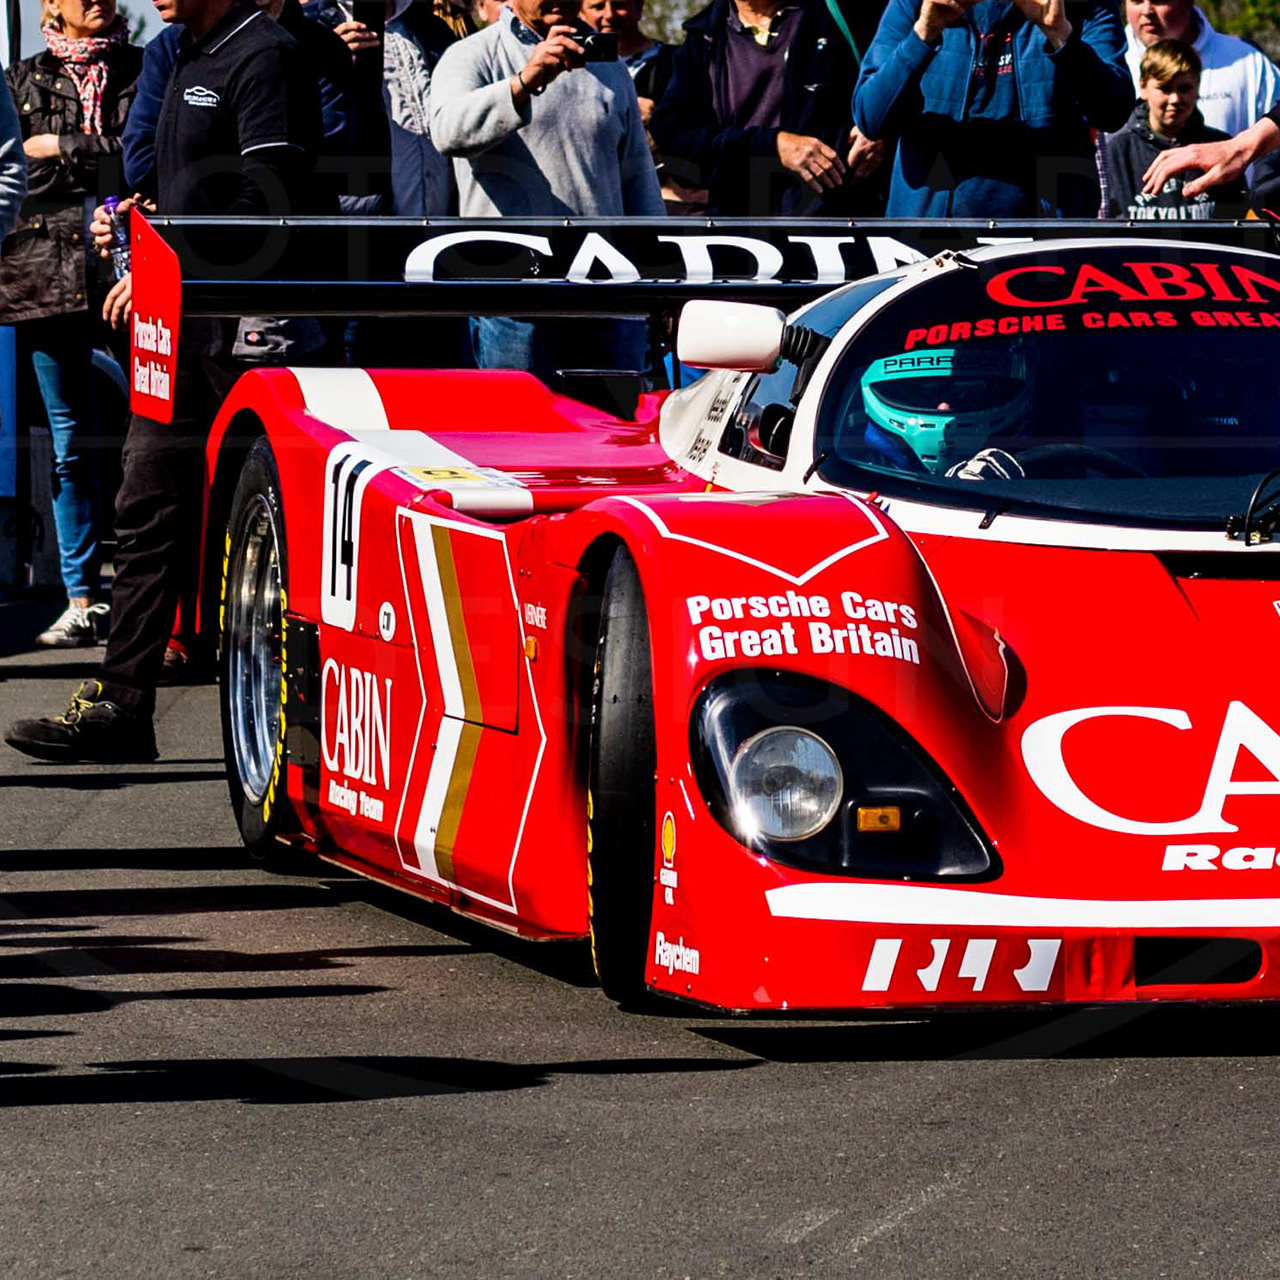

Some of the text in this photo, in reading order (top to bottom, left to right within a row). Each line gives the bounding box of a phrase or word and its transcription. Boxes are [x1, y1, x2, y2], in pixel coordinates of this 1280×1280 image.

[904, 313, 1064, 350] PORSCHE
[1083, 310, 1179, 328] CARS
[331, 453, 373, 601] 14
[686, 590, 918, 629] Porsche Cars
[699, 622, 920, 665] Great Britain
[321, 657, 393, 791] CABIN
[328, 778, 385, 823] Racing Team
[654, 930, 700, 976] Raychem
